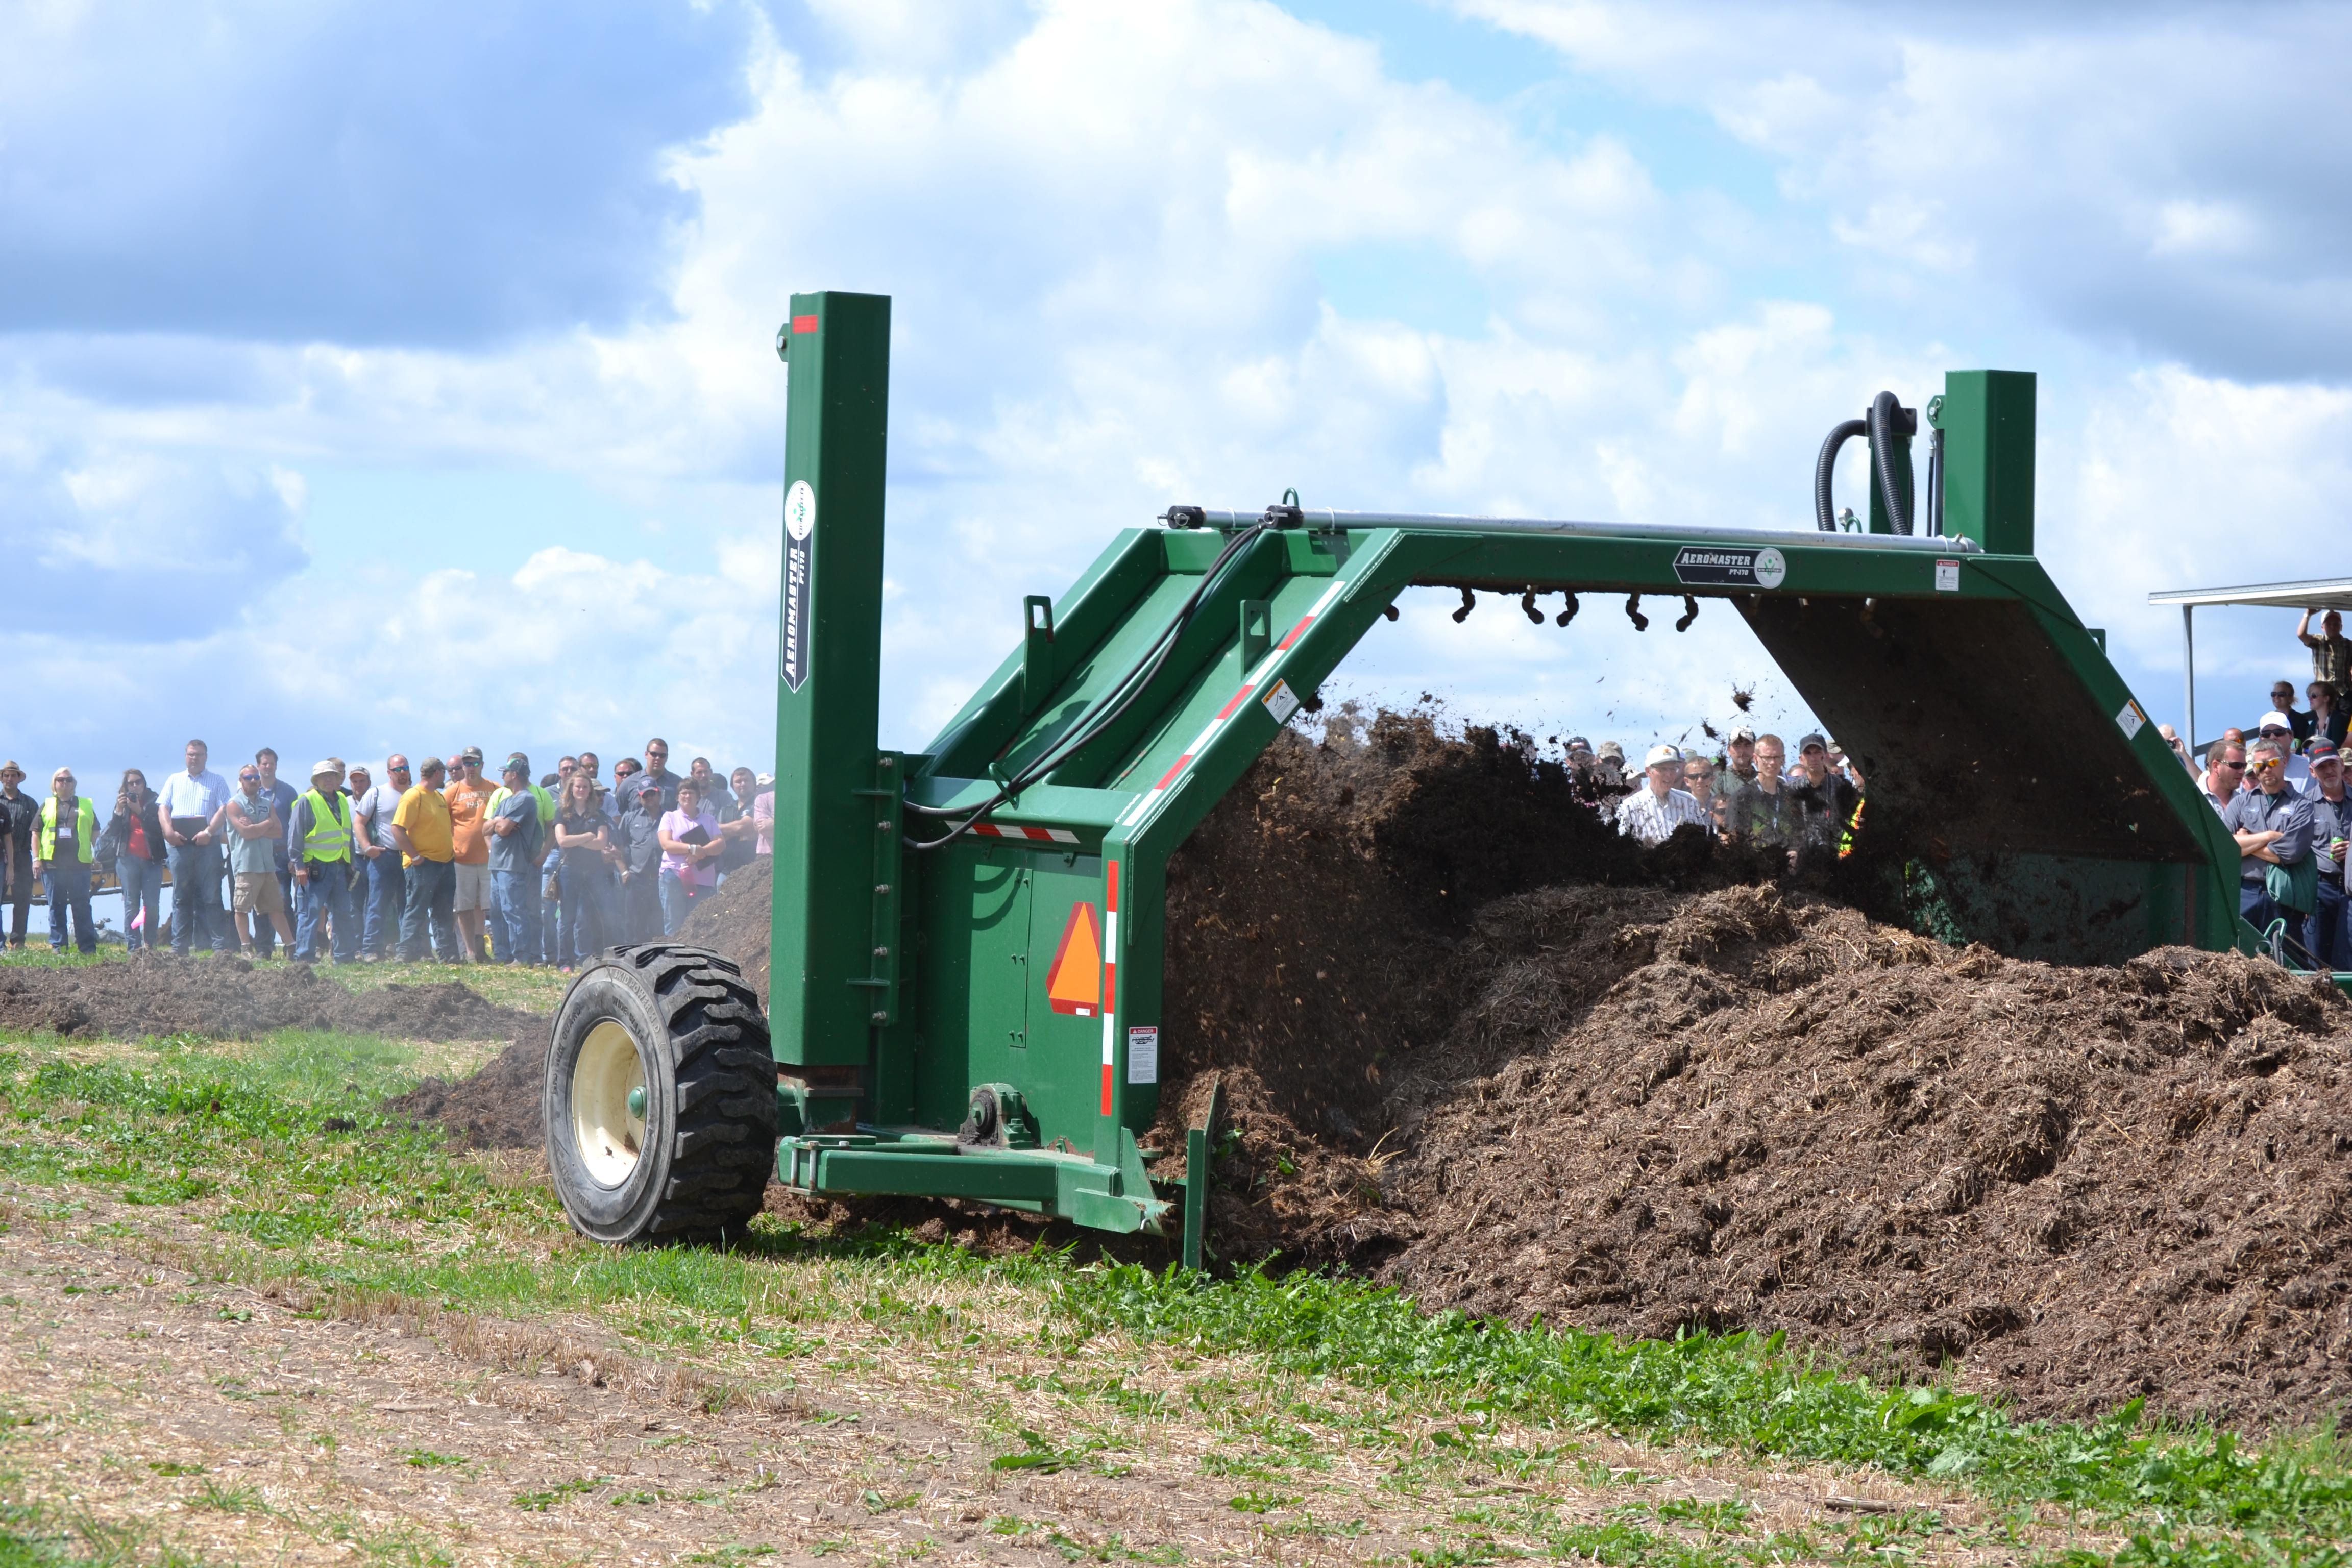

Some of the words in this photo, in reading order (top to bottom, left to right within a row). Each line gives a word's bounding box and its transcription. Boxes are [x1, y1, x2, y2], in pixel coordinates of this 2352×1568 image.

[1681, 553, 1751, 566] AEROMASTER
[786, 548, 798, 677] AEROMASTER
[1268, 681, 1283, 698] WARNING
[614, 969, 629, 985] SKID
[630, 979, 652, 1014] POWER
[562, 1006, 581, 1040] GUARD
[612, 995, 628, 1015] WIDE
[629, 1012, 644, 1044] WALL
